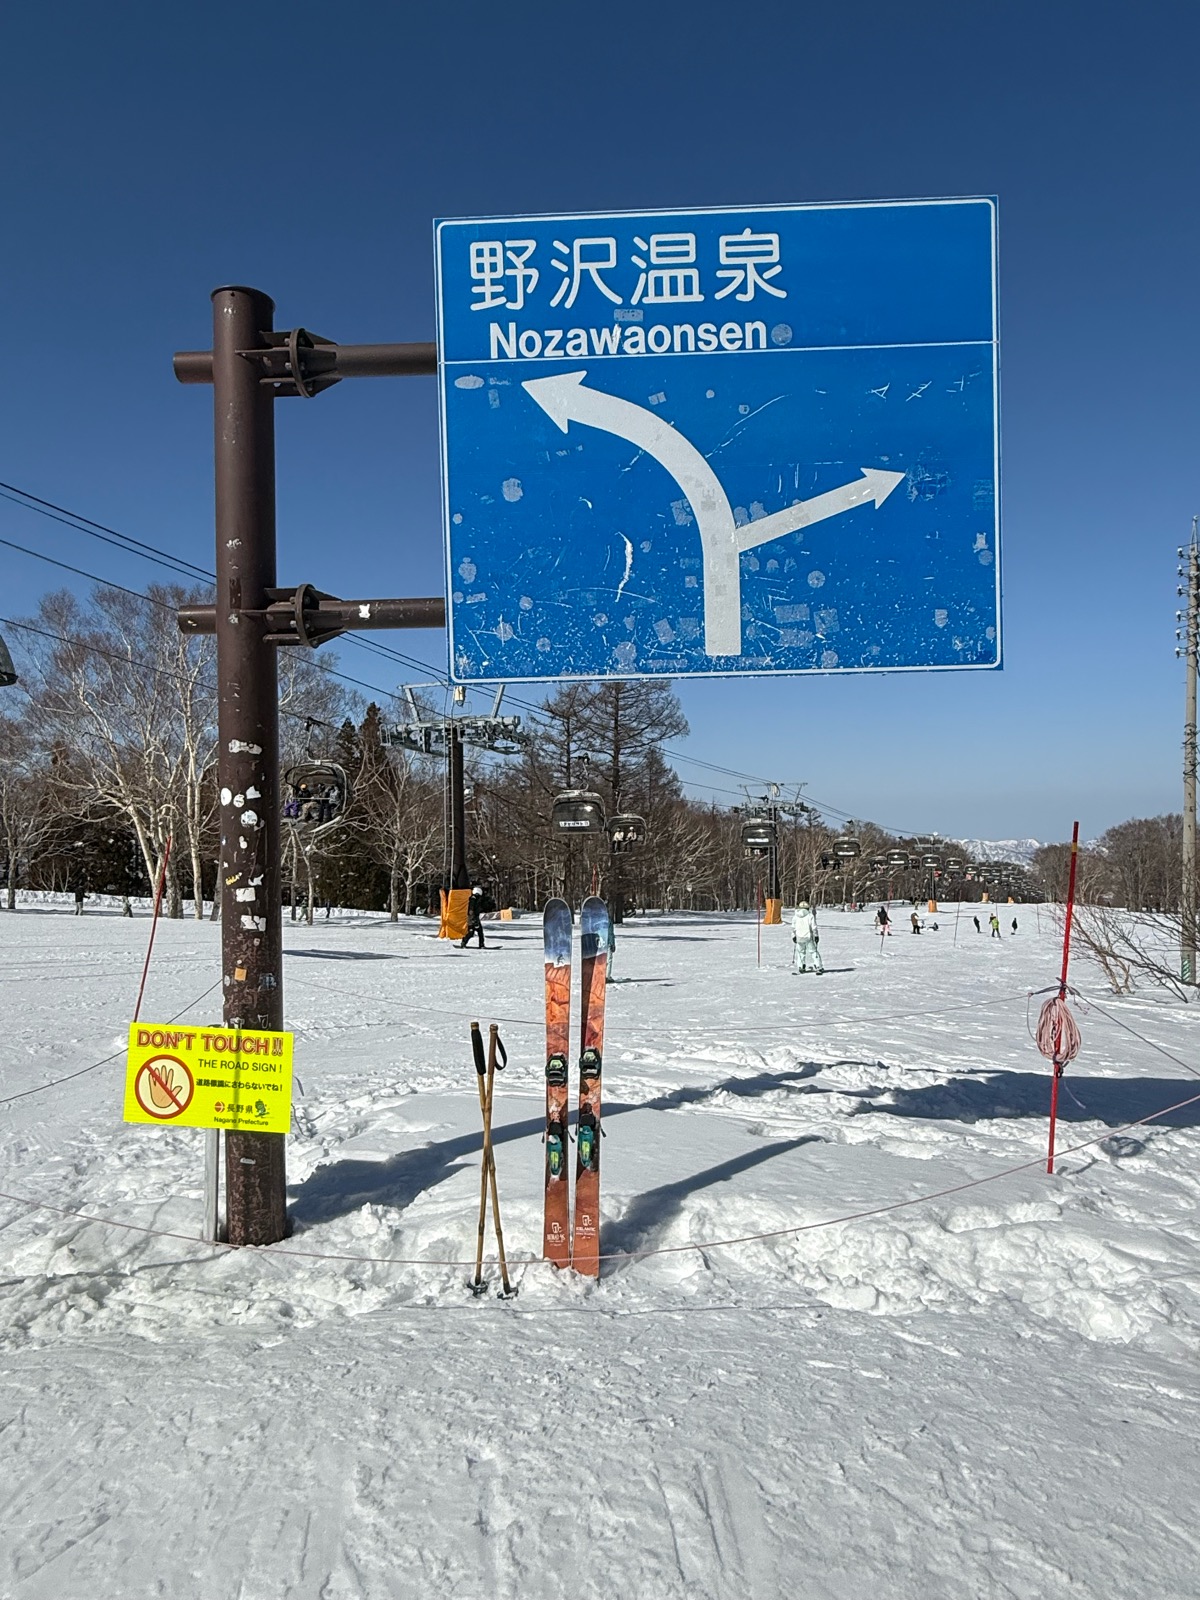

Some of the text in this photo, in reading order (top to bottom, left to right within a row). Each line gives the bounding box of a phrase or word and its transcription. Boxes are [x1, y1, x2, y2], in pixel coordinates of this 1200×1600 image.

[470, 227, 788, 311] 野沢温泉
[489, 320, 768, 359] Nozawaonsen
[137, 1029, 197, 1051] DON'T
[198, 1058, 218, 1069] THE
[220, 1060, 250, 1071] ROAD
[227, 1103, 254, 1114] 長野県
[213, 1116, 269, 1126] Nagano Prefecture
